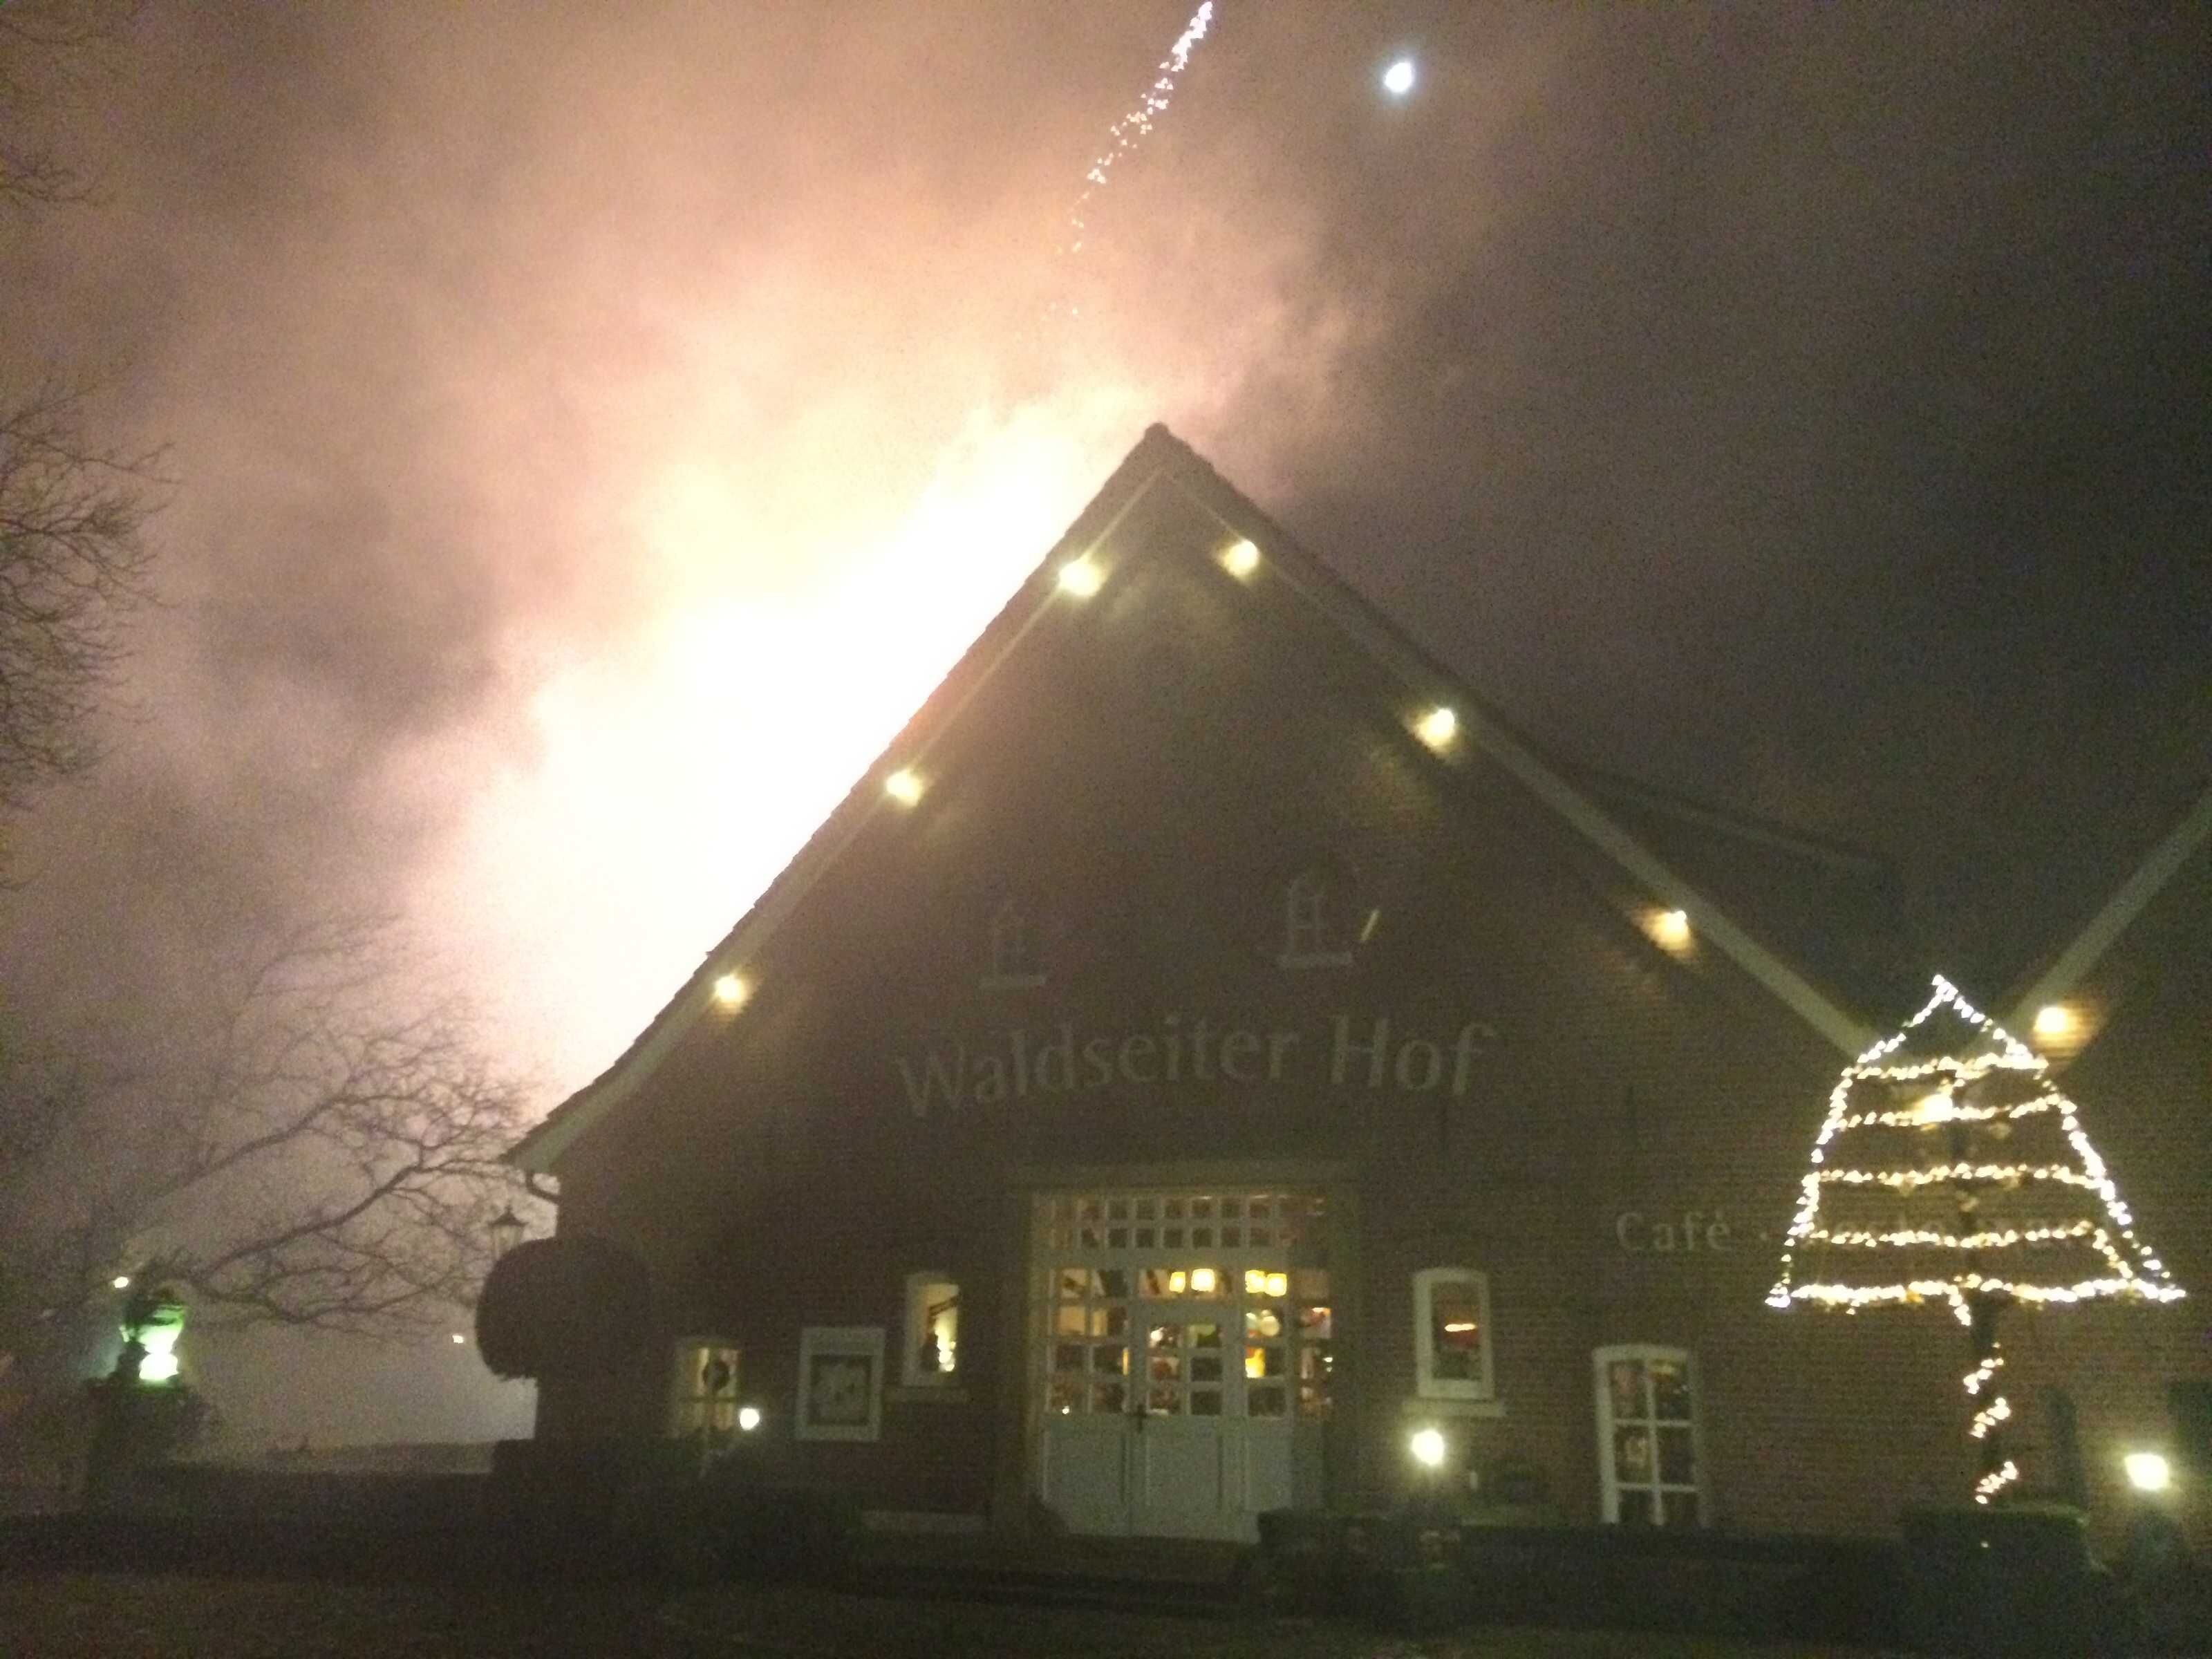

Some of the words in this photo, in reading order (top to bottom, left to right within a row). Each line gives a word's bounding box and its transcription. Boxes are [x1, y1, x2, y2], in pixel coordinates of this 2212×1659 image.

[895, 1014, 1300, 1118] Waldseiter
[1332, 1016, 1497, 1096] Hof
[1615, 1210, 1734, 1253] Café
